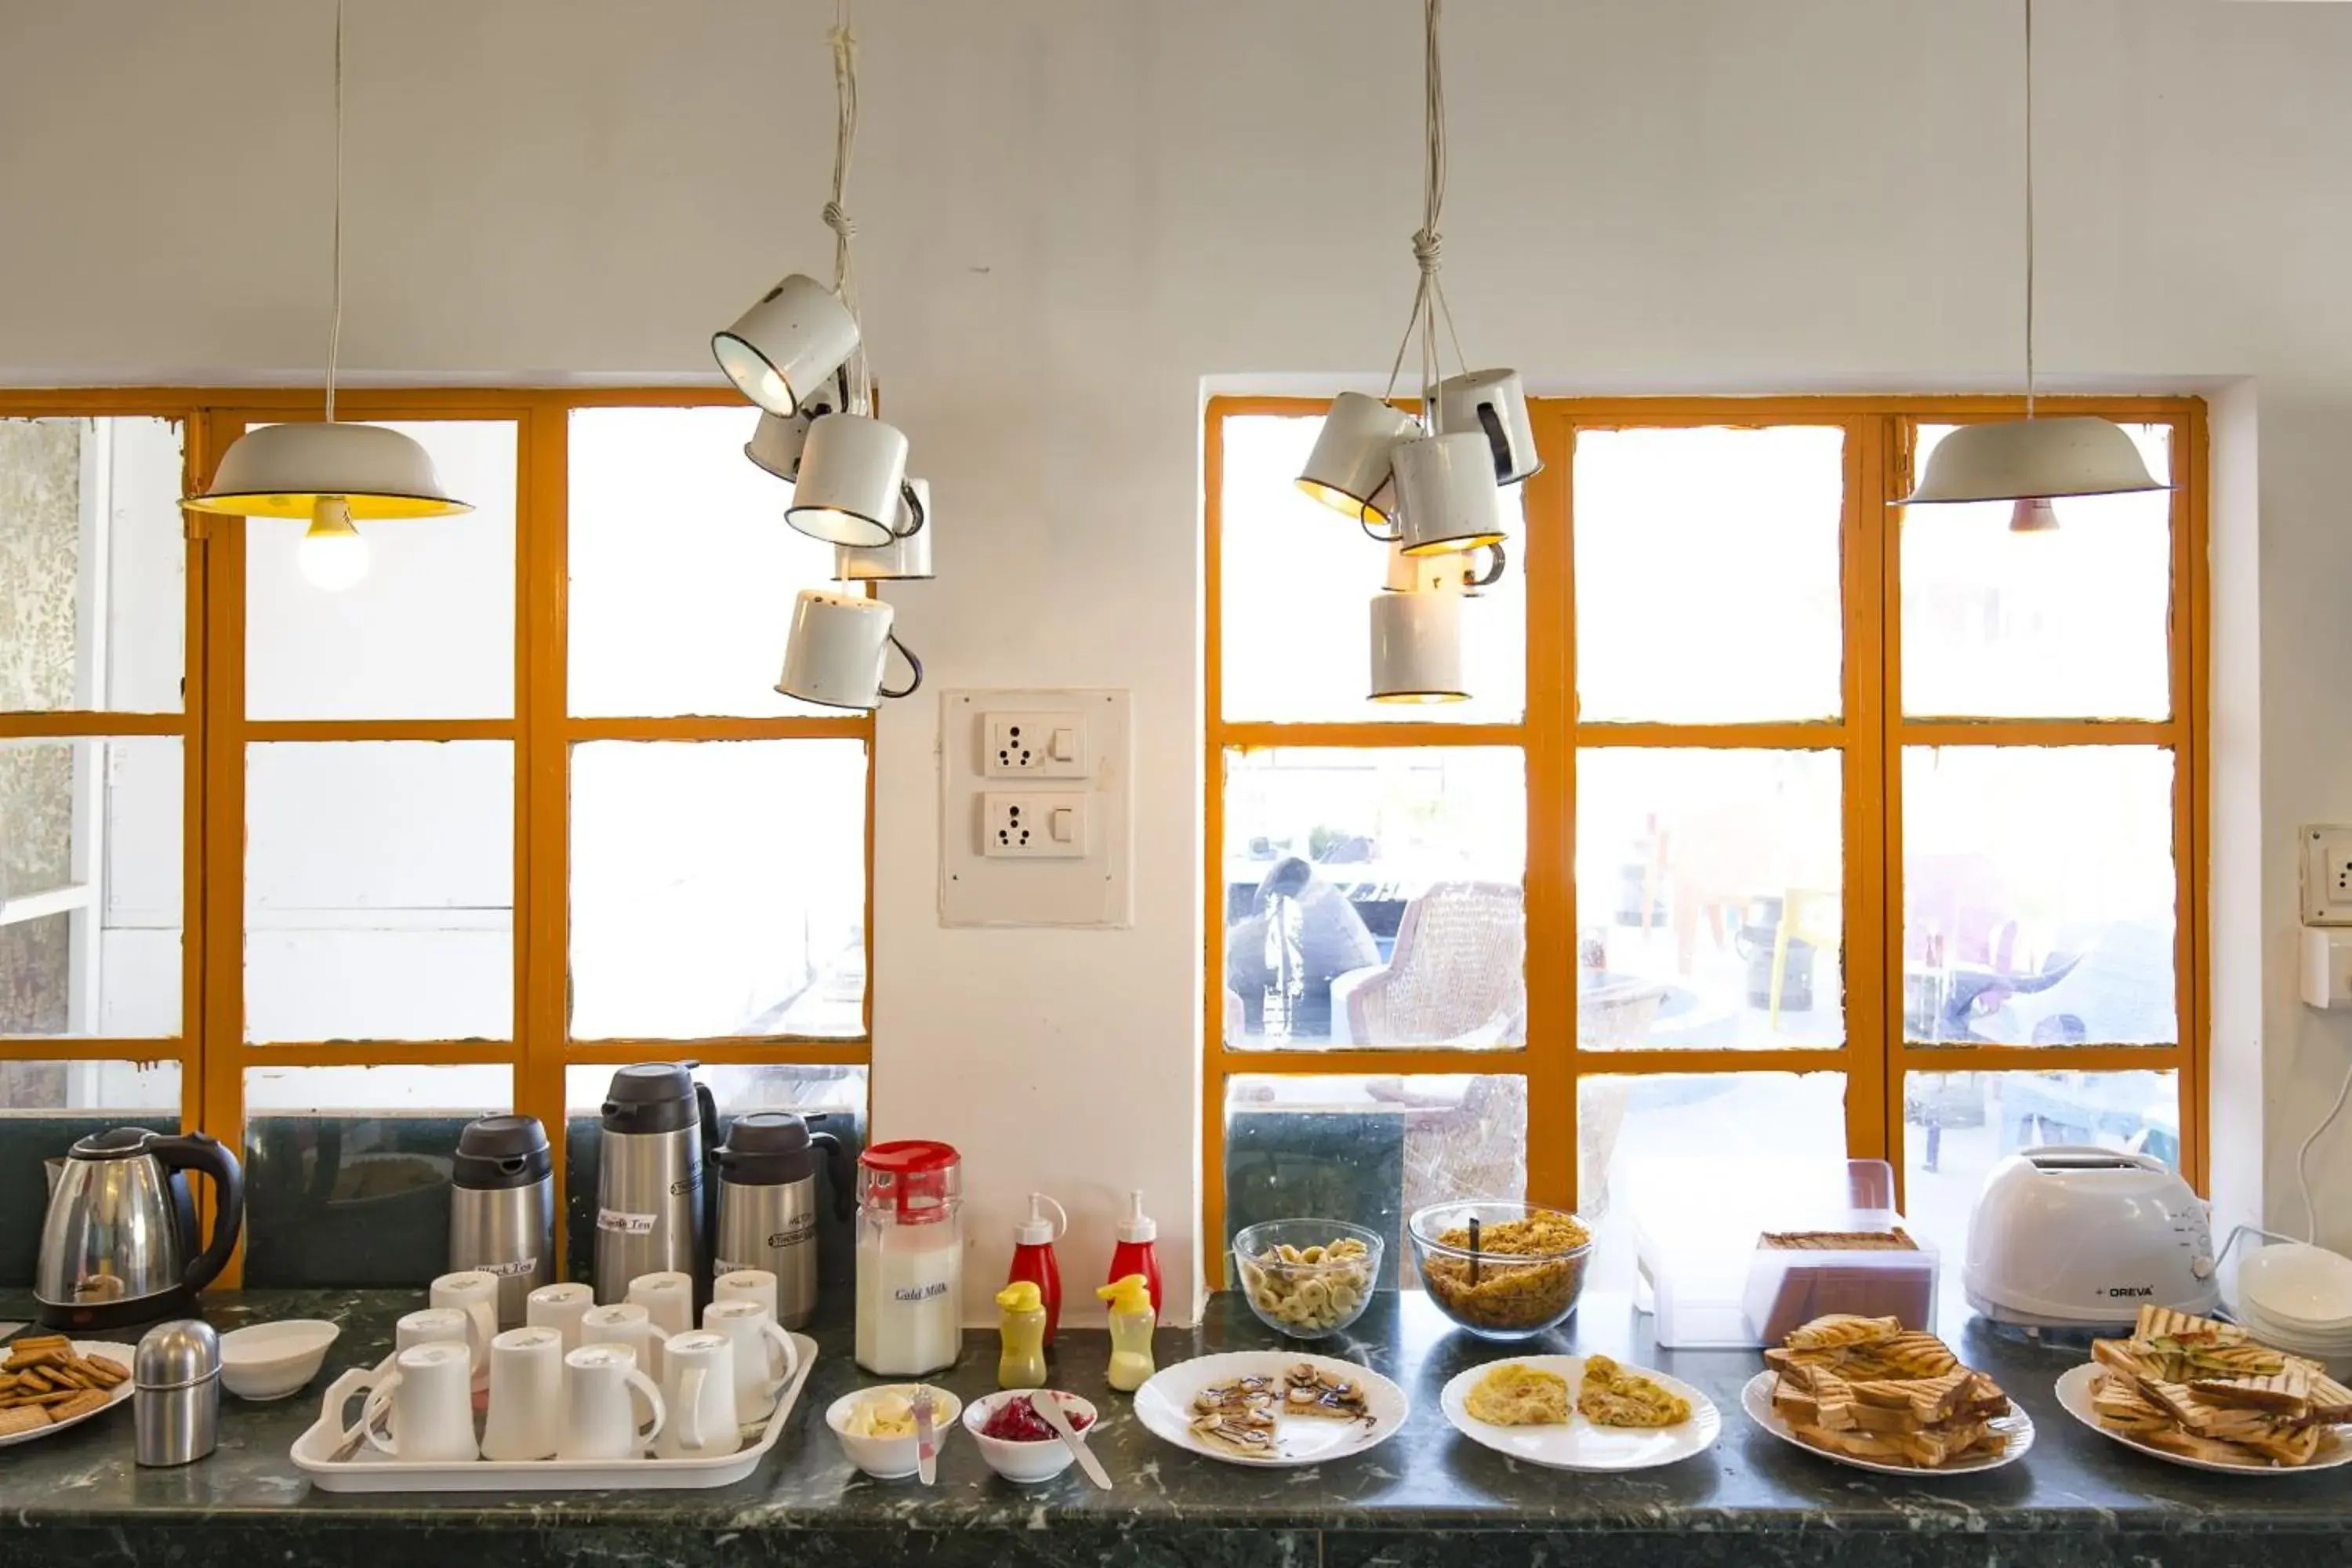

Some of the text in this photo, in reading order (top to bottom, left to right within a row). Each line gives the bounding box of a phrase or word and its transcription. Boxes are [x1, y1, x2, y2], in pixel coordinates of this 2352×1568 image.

[633, 1218, 651, 1229] Tea
[514, 1263, 532, 1274] Tea
[895, 1288, 922, 1301] Cold
[2109, 1287, 2153, 1298] OREVA
